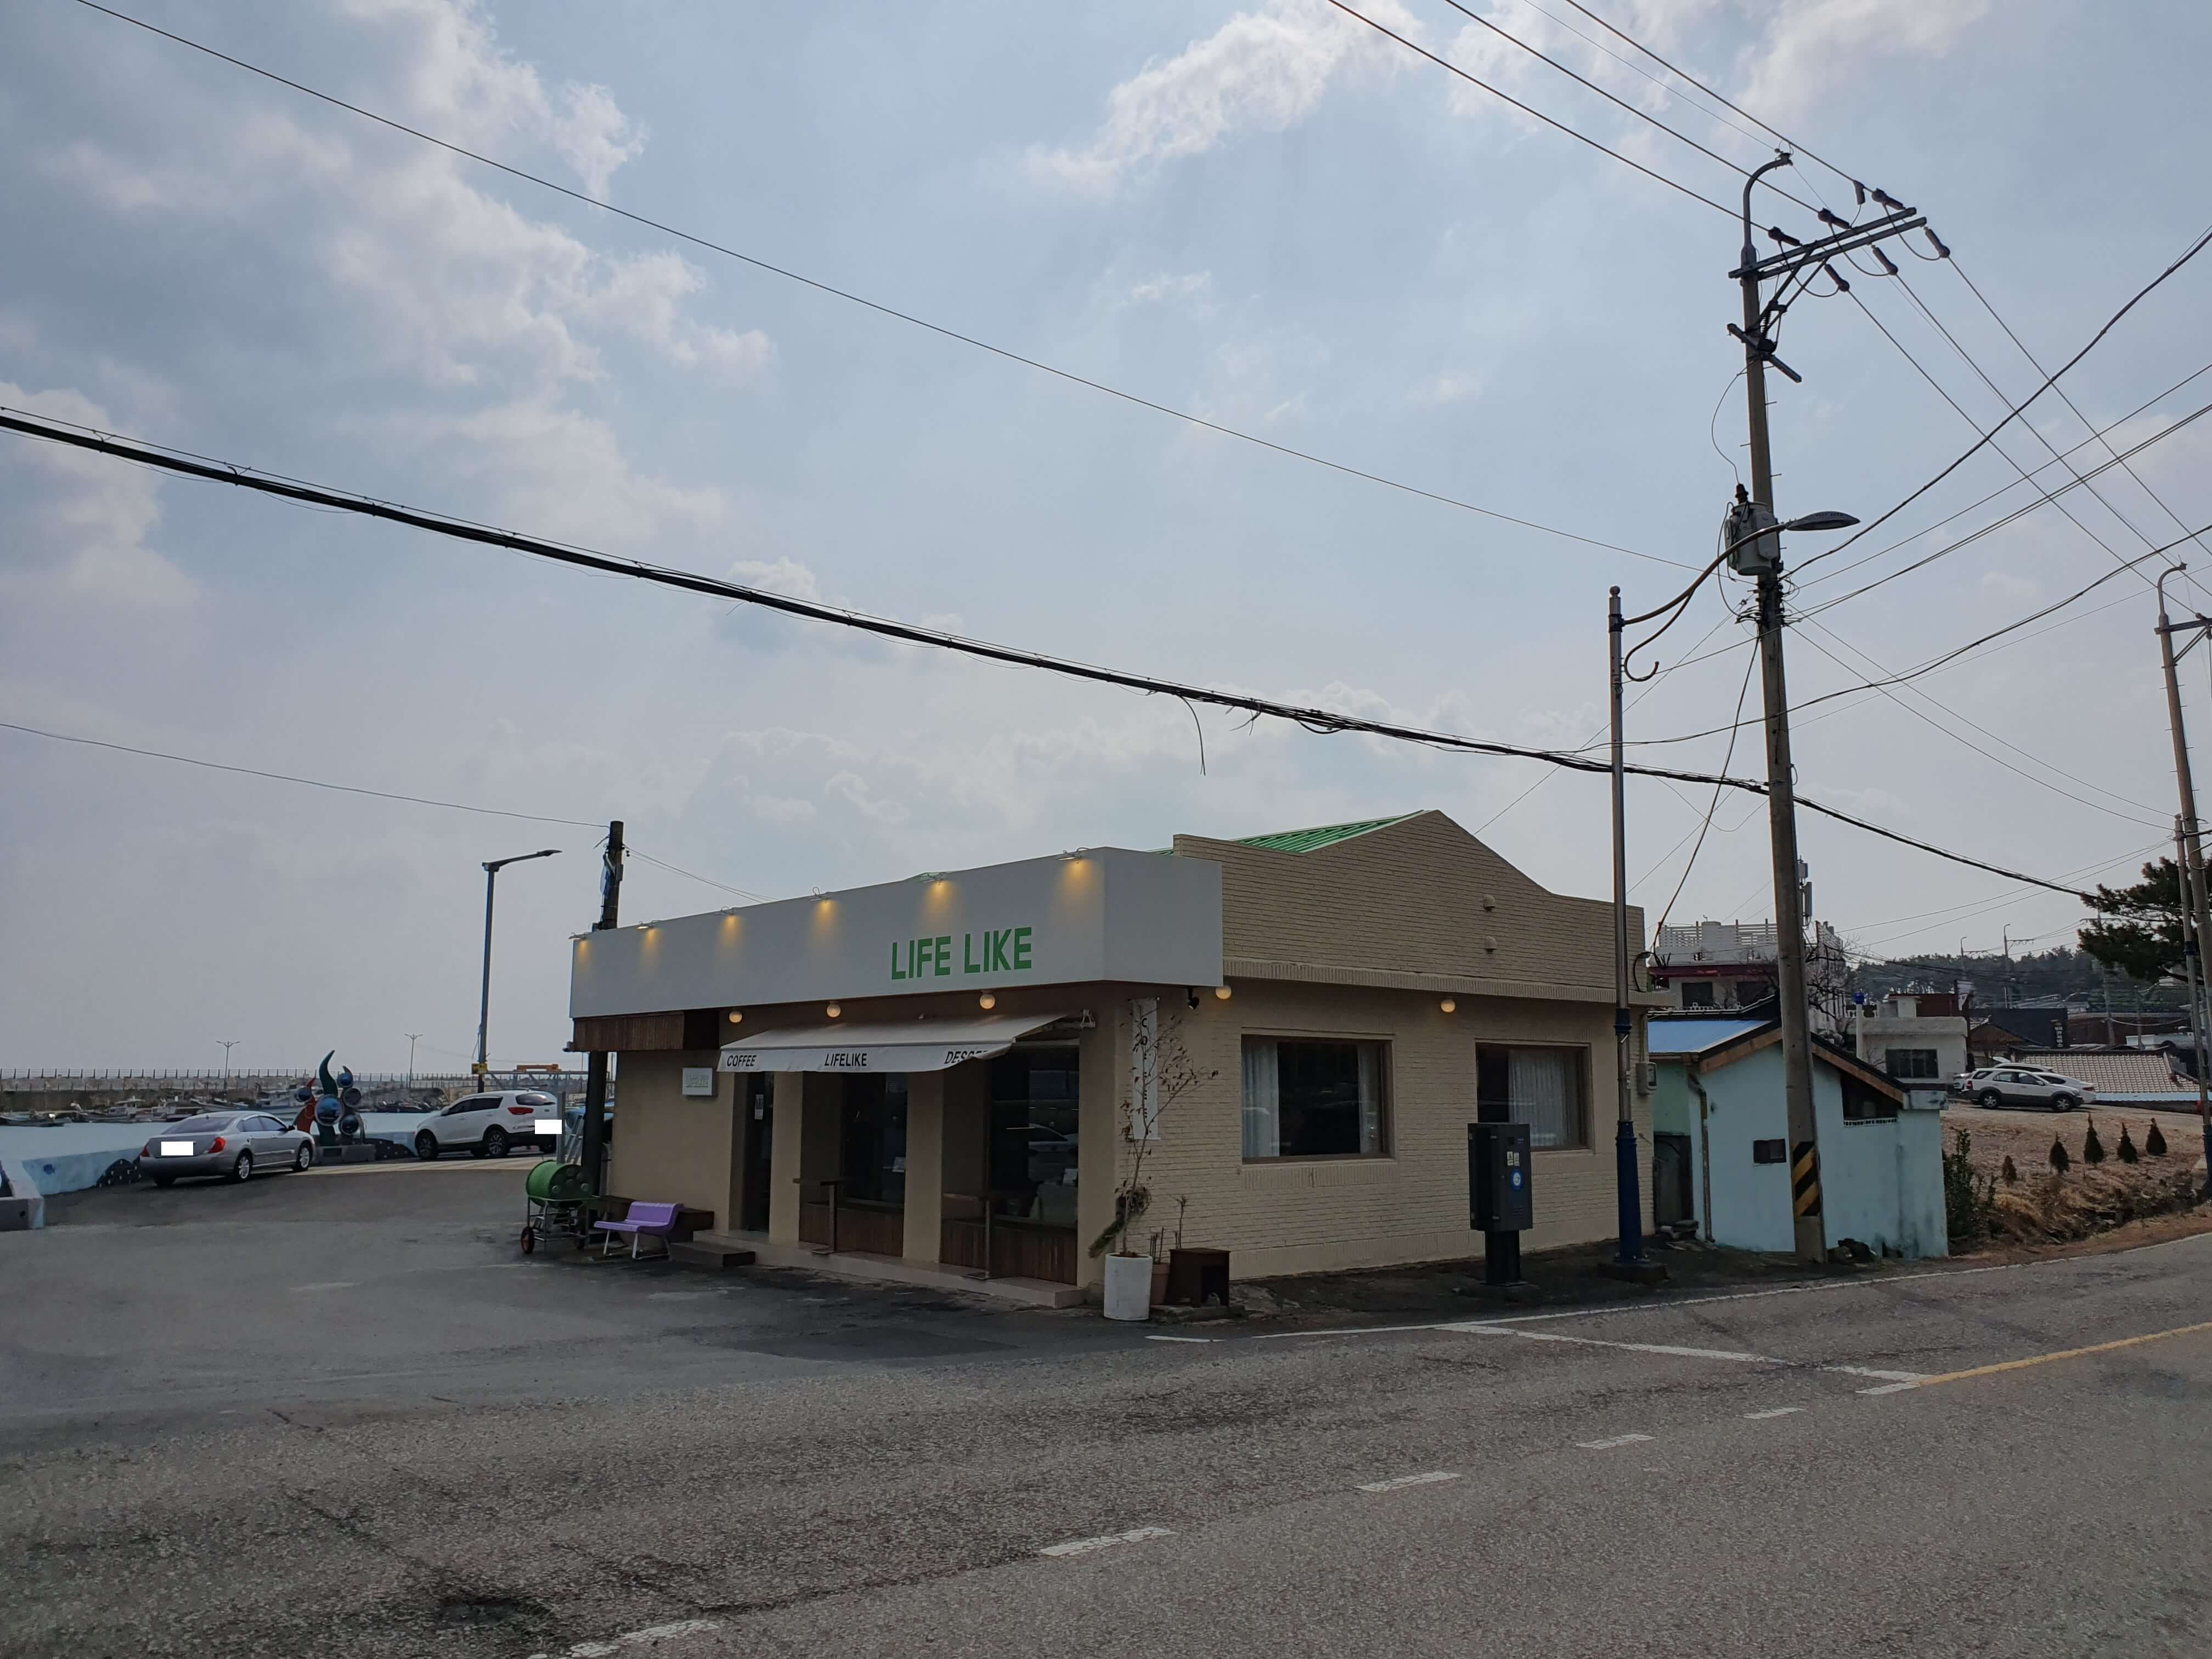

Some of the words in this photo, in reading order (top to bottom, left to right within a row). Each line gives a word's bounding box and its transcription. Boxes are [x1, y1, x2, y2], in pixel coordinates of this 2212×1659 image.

[891, 935, 951, 980] LIFE
[964, 927, 1032, 974] LIKE
[727, 1055, 757, 1067] COFFEE
[825, 1053, 867, 1066] LIFELIKE
